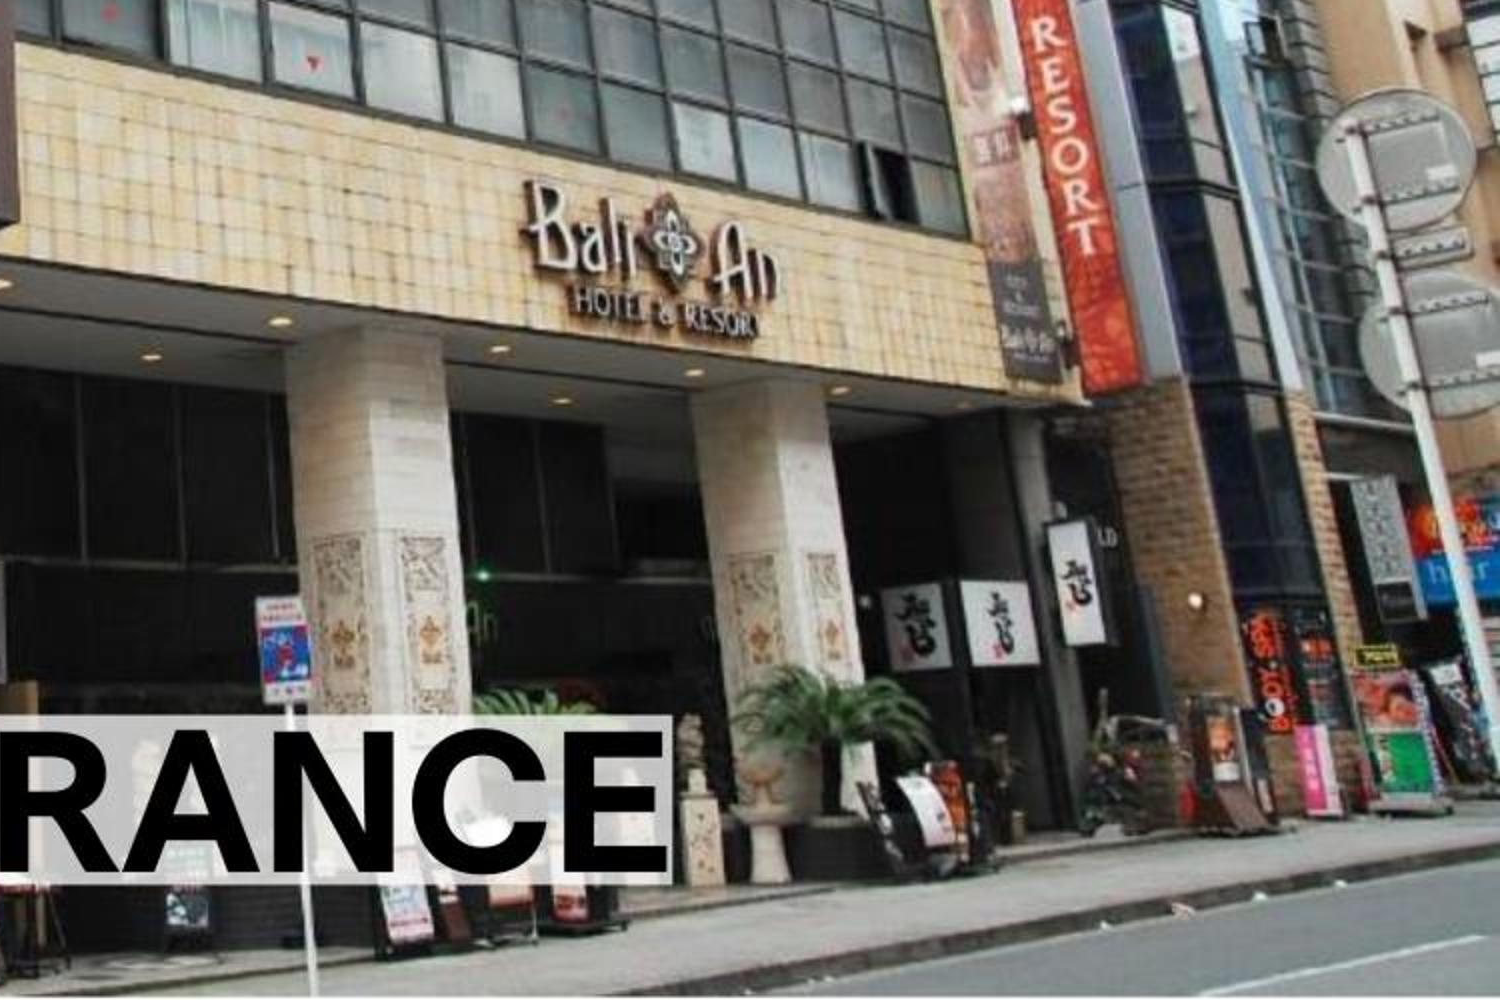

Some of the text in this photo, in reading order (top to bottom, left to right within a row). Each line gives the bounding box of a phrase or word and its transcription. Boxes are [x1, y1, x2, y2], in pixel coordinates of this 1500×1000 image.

[1029, 16, 1097, 258] RESORT
[524, 178, 780, 300] Bali An
[573, 283, 644, 322] HOTEL
[658, 297, 678, 327] &
